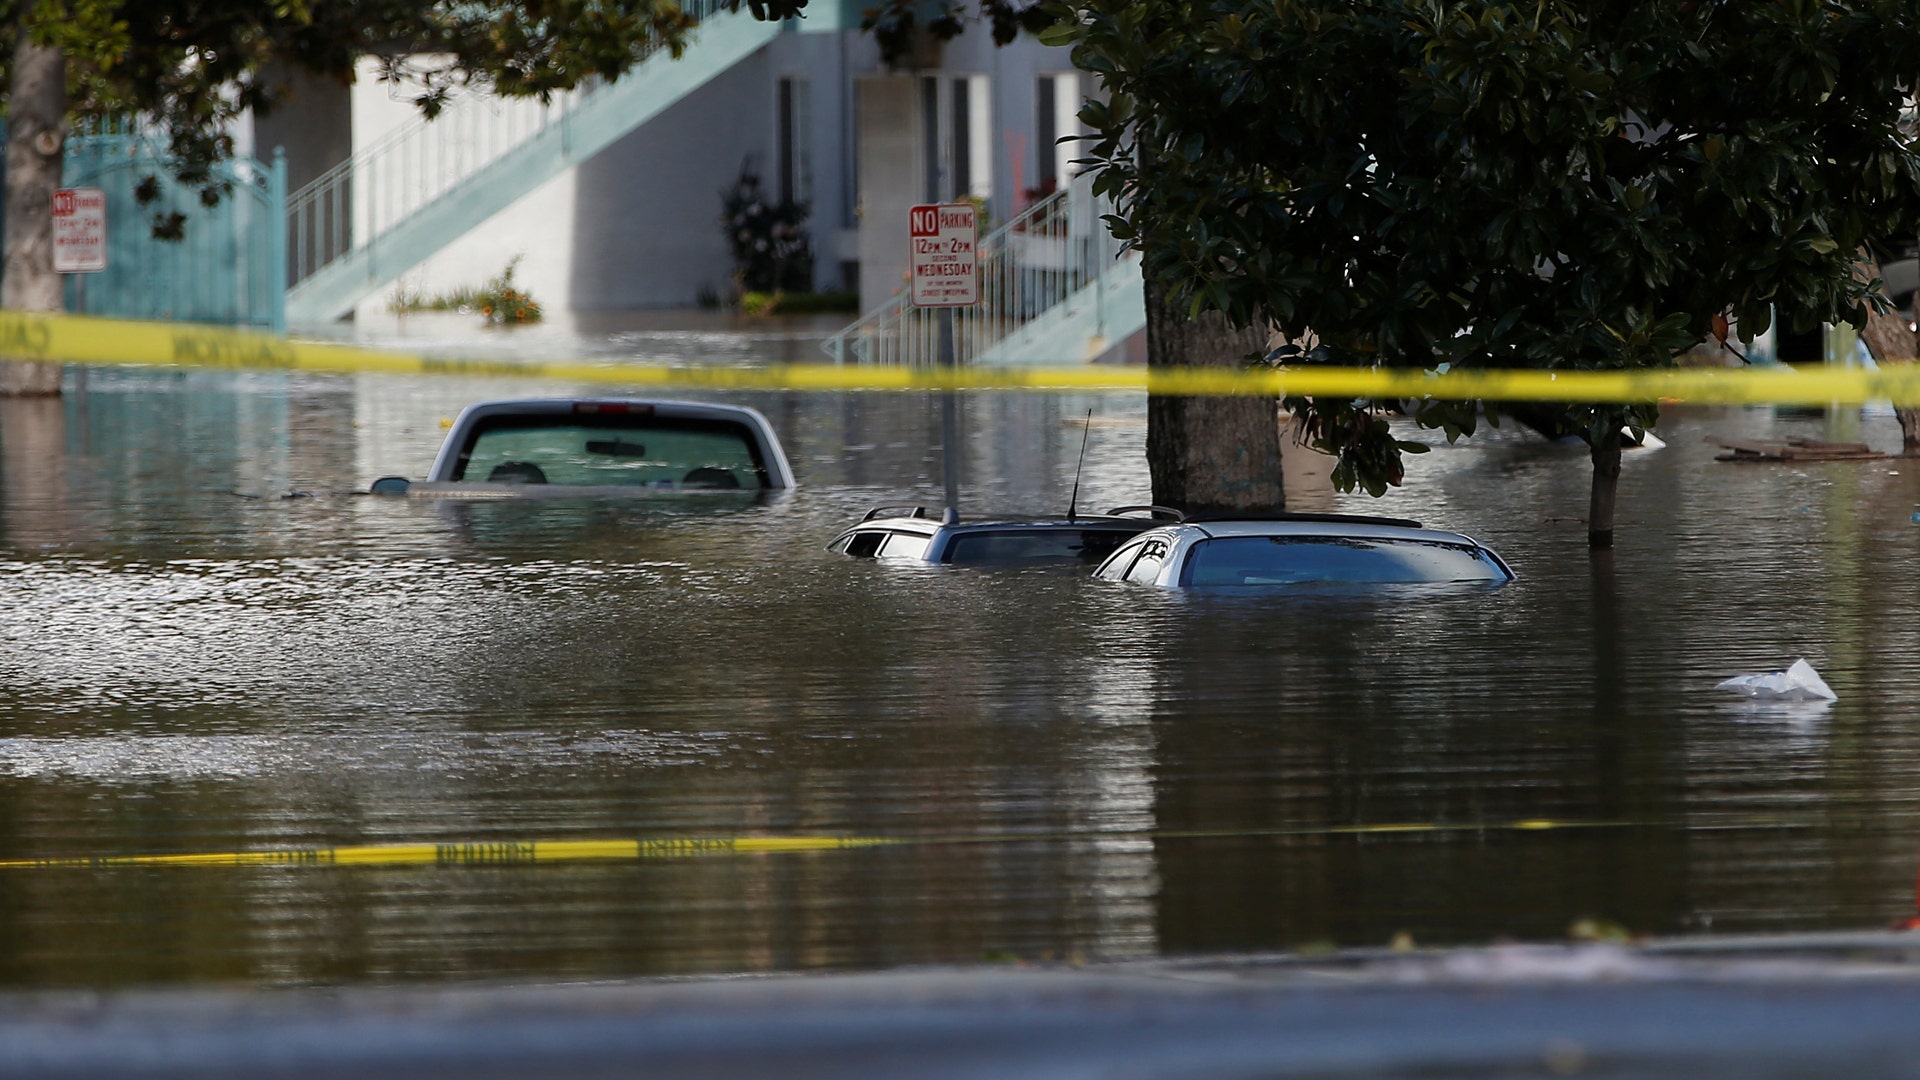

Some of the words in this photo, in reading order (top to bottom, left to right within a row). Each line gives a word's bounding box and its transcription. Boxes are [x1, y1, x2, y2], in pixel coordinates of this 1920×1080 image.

[913, 211, 937, 233] NO
[940, 212, 972, 228] PARKING
[916, 263, 972, 277] WEDNESDAY
